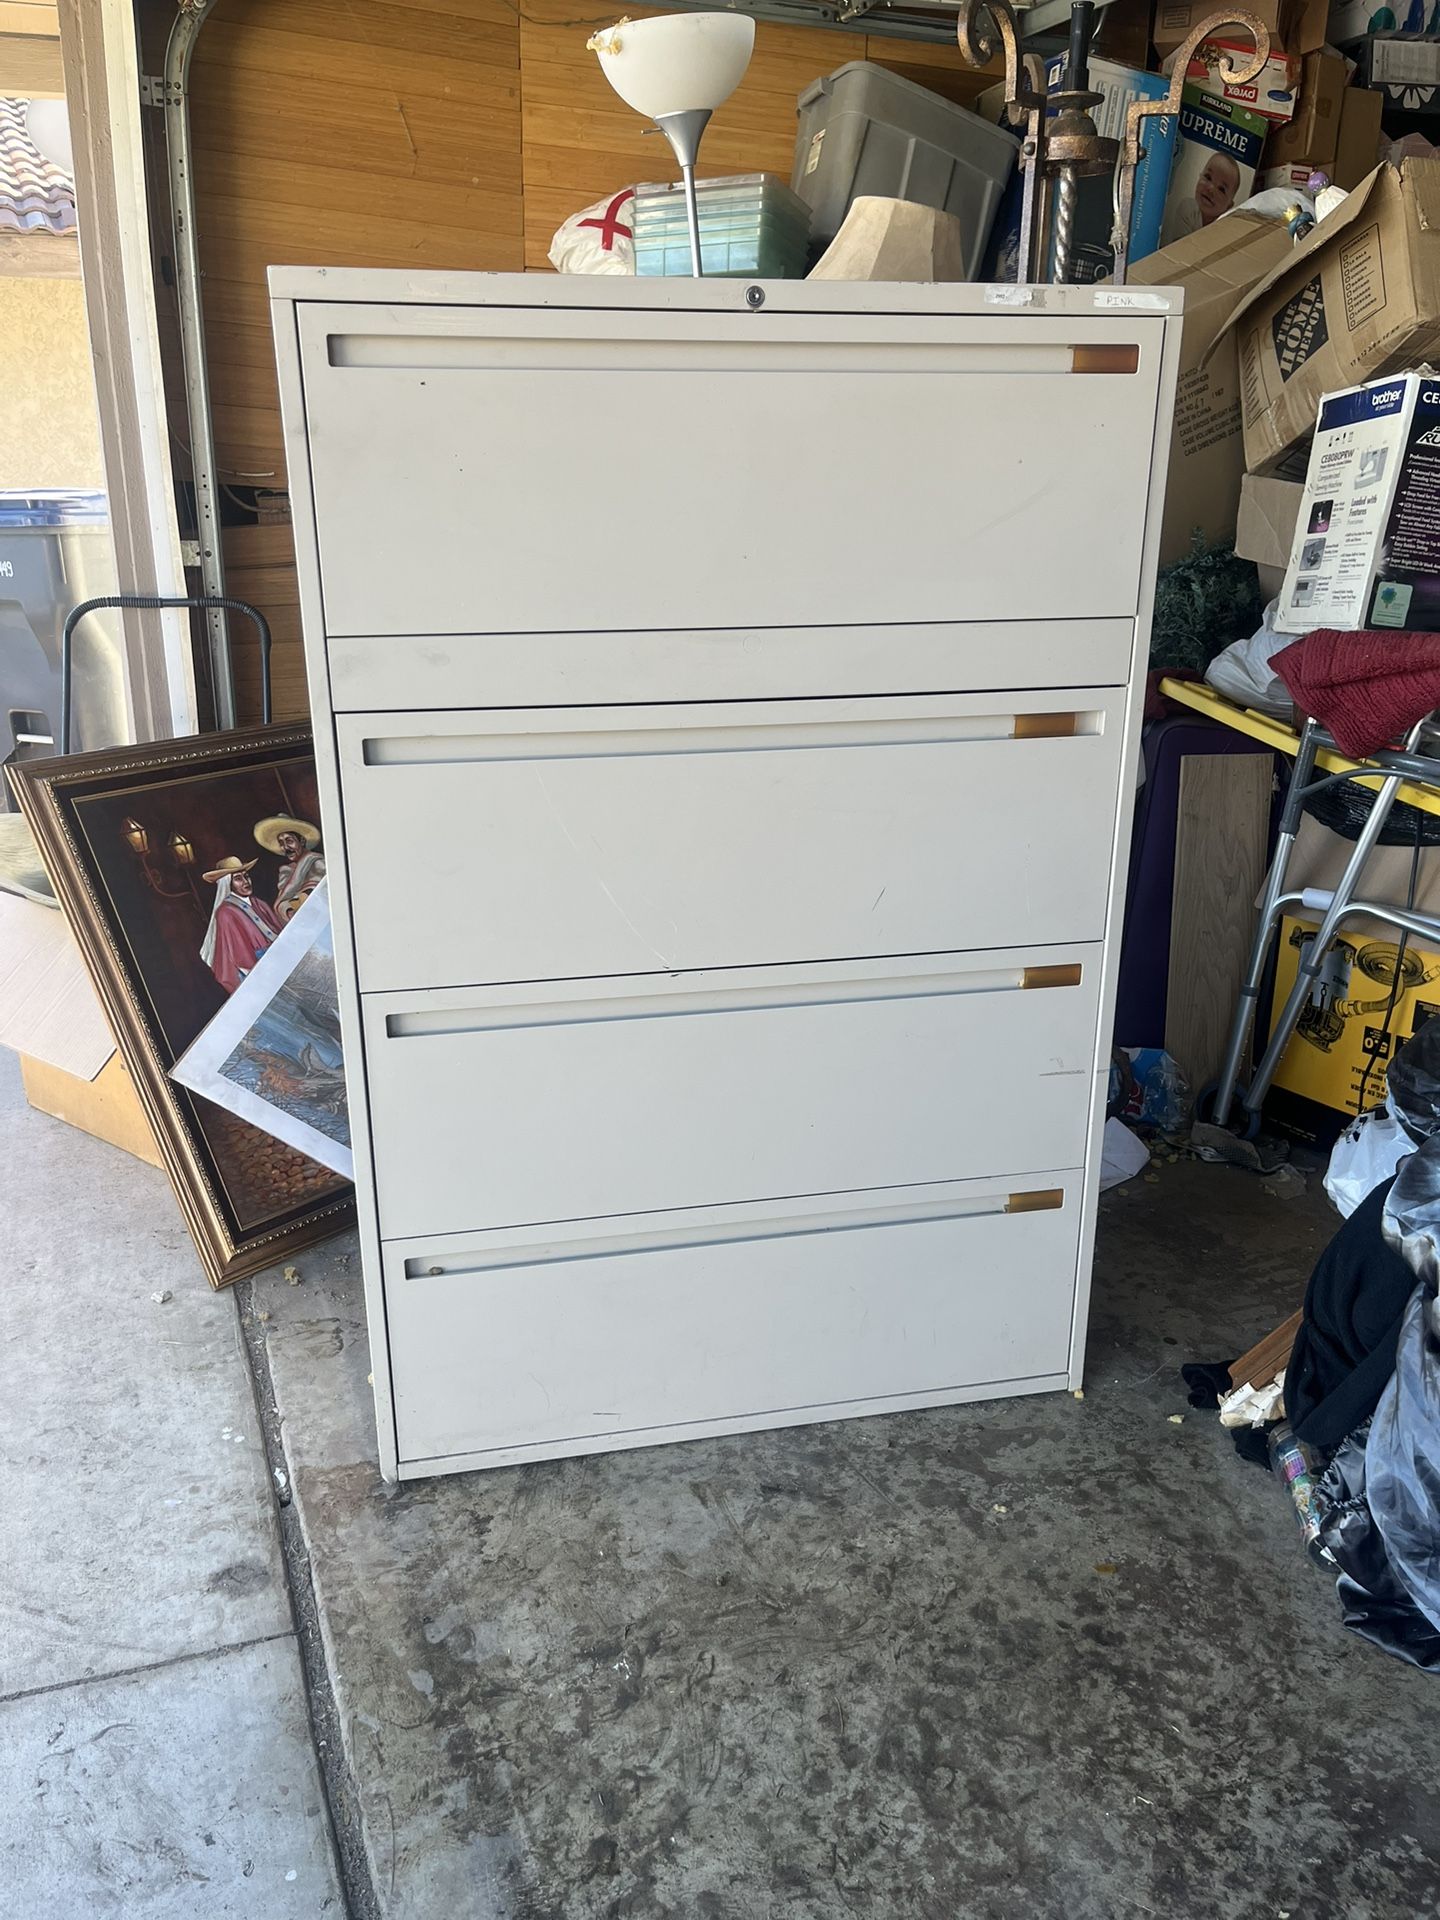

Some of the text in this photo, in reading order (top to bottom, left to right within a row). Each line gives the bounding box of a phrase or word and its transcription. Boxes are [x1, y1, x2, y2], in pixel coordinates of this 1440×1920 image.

[1228, 86, 1256, 99] pyrex
[1202, 94, 1232, 113] KIRKLAND
[1145, 133, 1155, 172] Countertop
[1139, 174, 1149, 210] Microwave
[1106, 295, 1135, 306] PINK
[1276, 303, 1298, 343] THE
[1282, 282, 1321, 374] HOME
[1295, 298, 1325, 366] DEPOT
[1371, 389, 1402, 406] brother
[1422, 391, 1440, 404] CE
[1367, 494, 1378, 504] with
[1349, 508, 1367, 517] Features
[0, 560, 14, 578] 49
